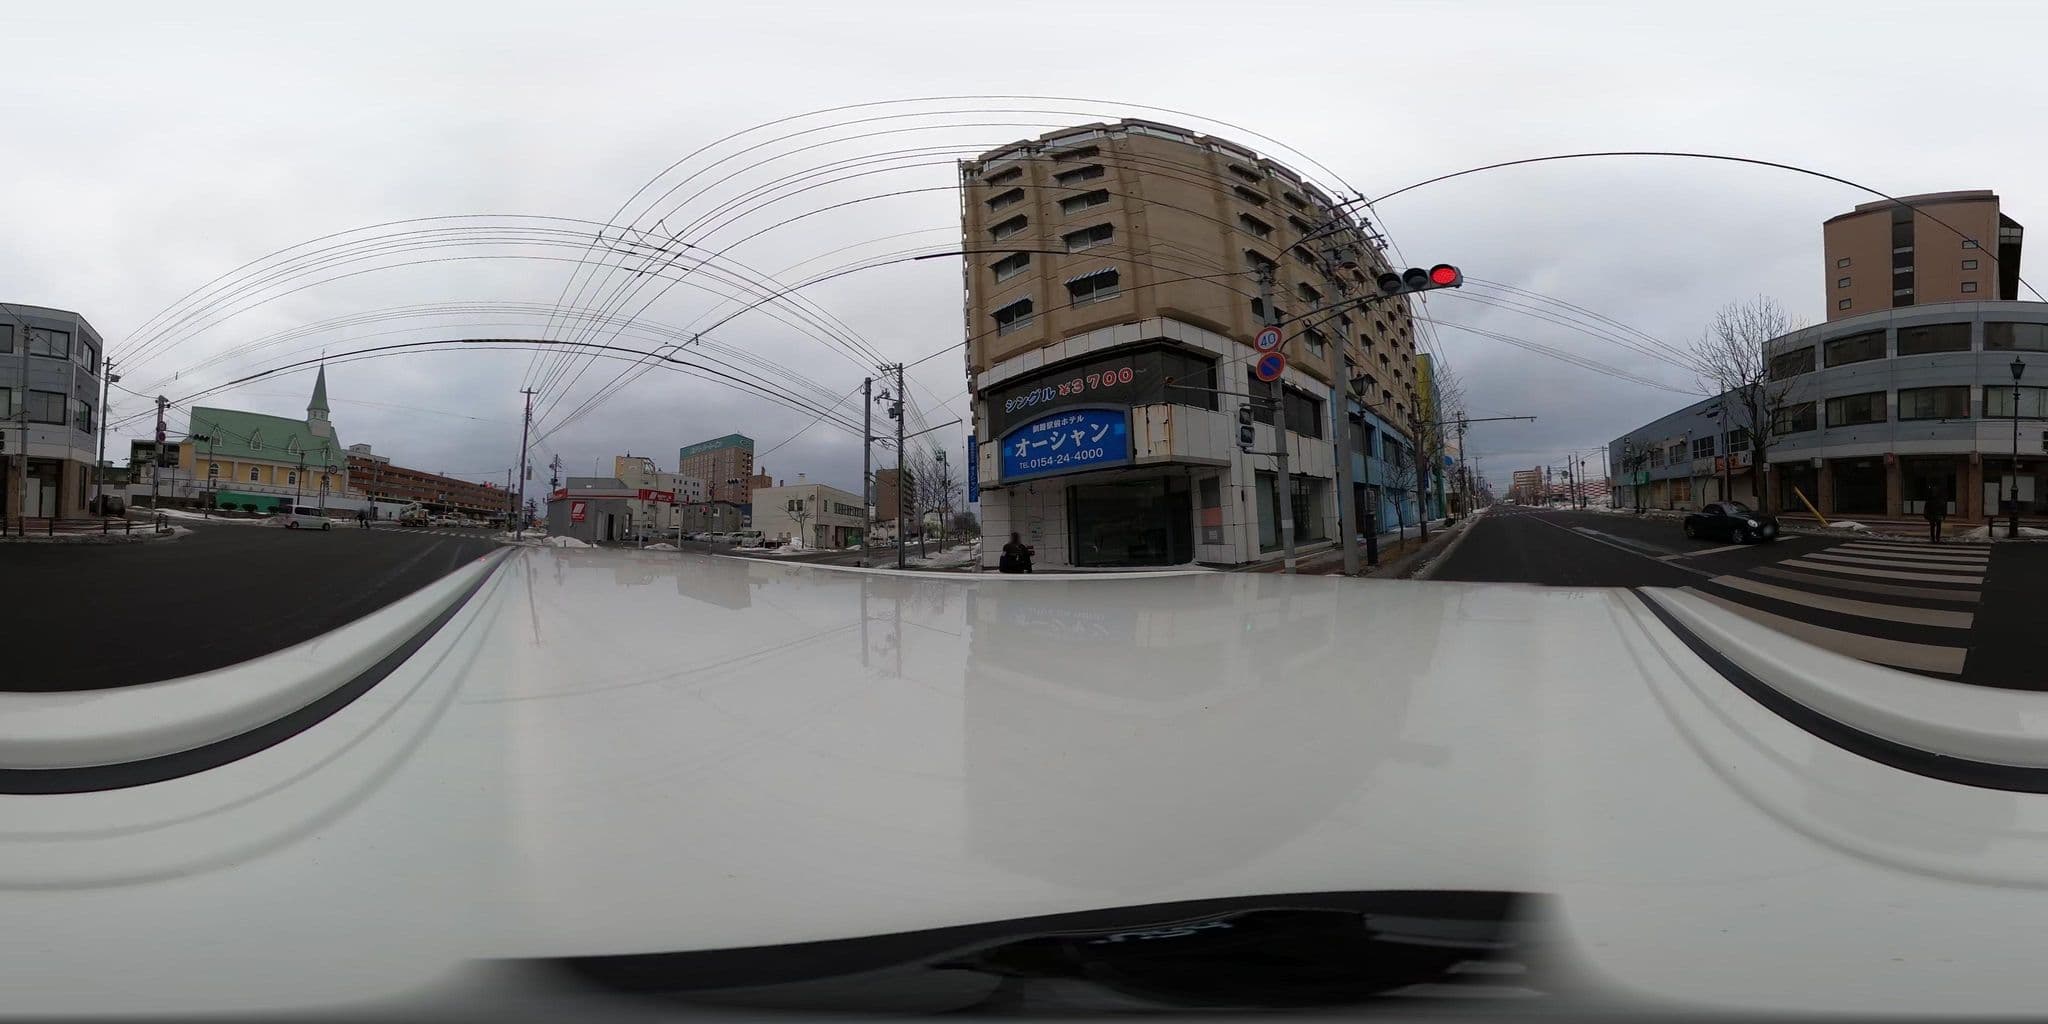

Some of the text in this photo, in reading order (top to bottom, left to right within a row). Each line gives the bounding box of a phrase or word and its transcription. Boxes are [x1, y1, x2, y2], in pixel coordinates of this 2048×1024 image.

[1261, 333, 1276, 346] 40
[1005, 386, 1056, 413] シングル
[1015, 423, 1109, 458] オーシャン
[1030, 448, 1104, 469] 0154-24-4000
